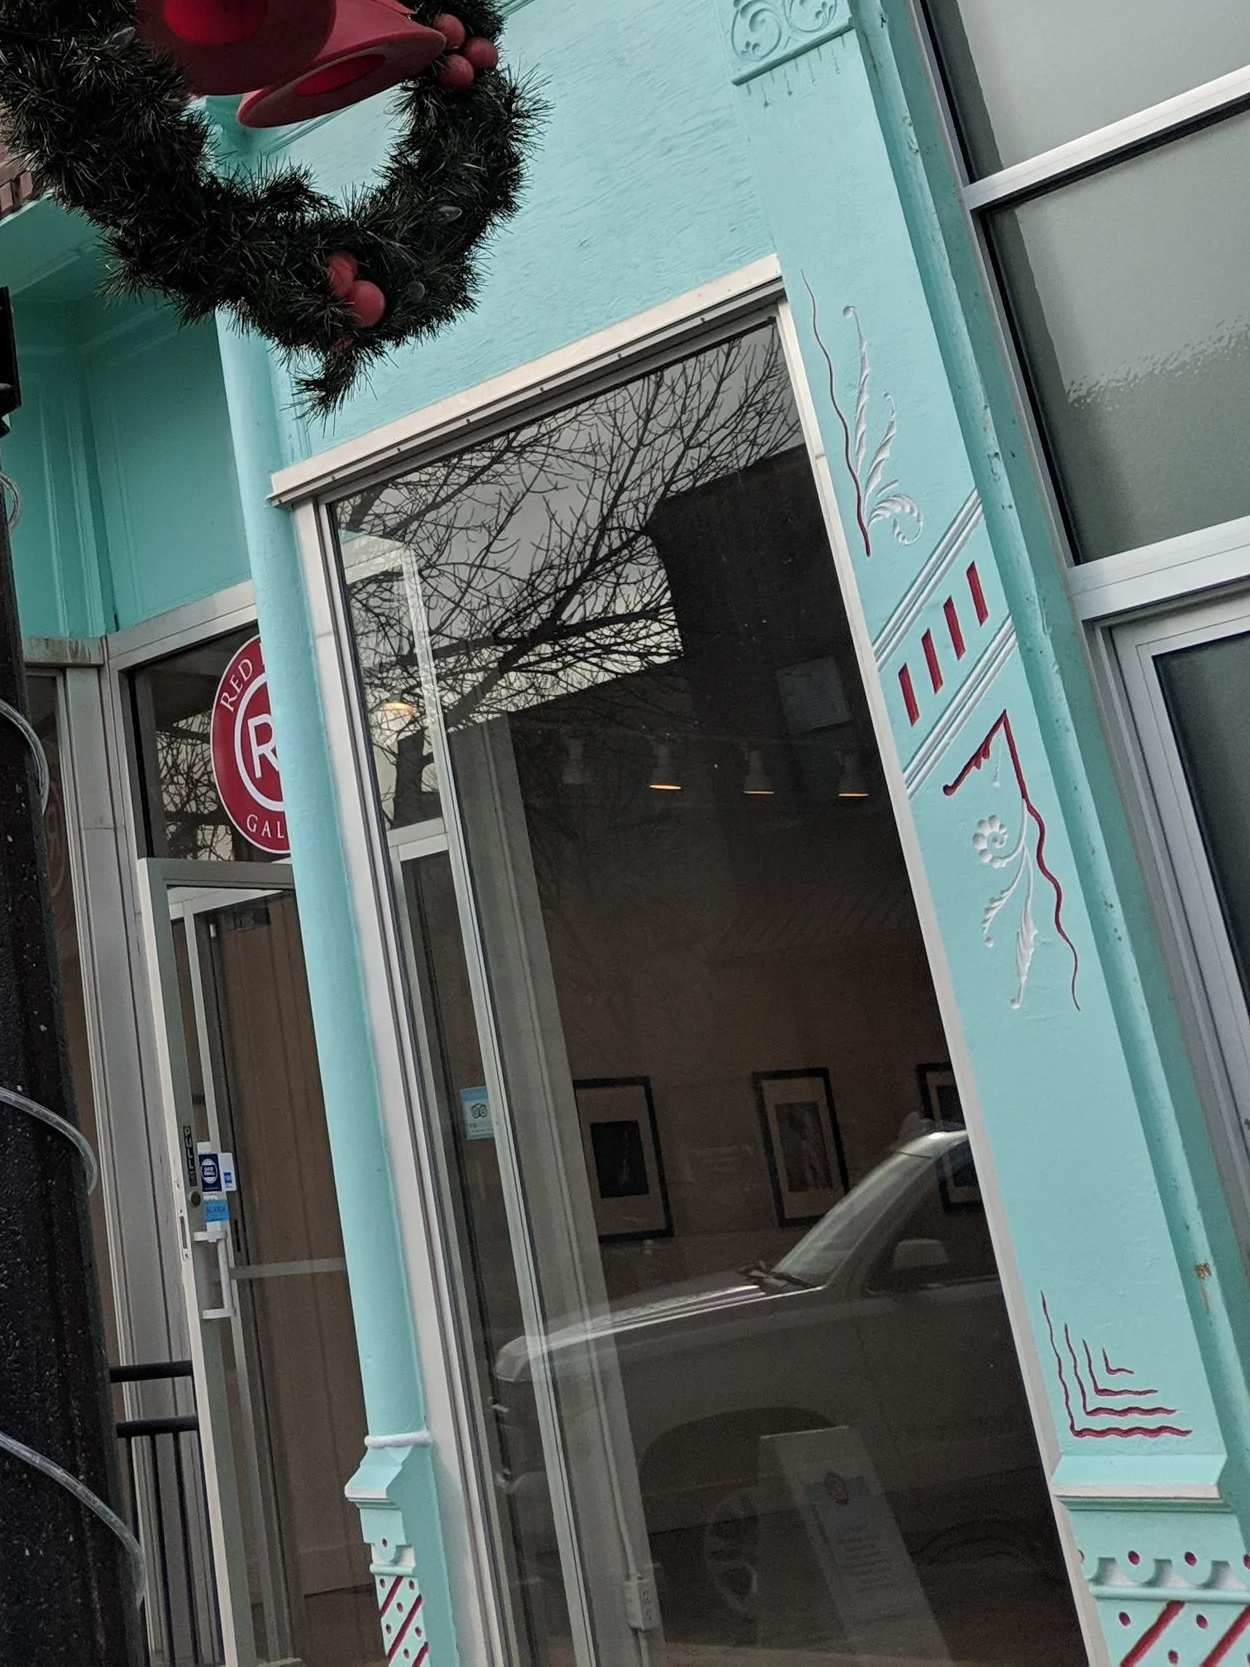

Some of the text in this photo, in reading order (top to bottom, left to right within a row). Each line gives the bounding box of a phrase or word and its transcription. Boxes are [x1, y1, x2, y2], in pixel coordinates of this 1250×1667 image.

[220, 658, 253, 712] RED
[247, 713, 279, 779] R
[246, 813, 285, 838] GAL
